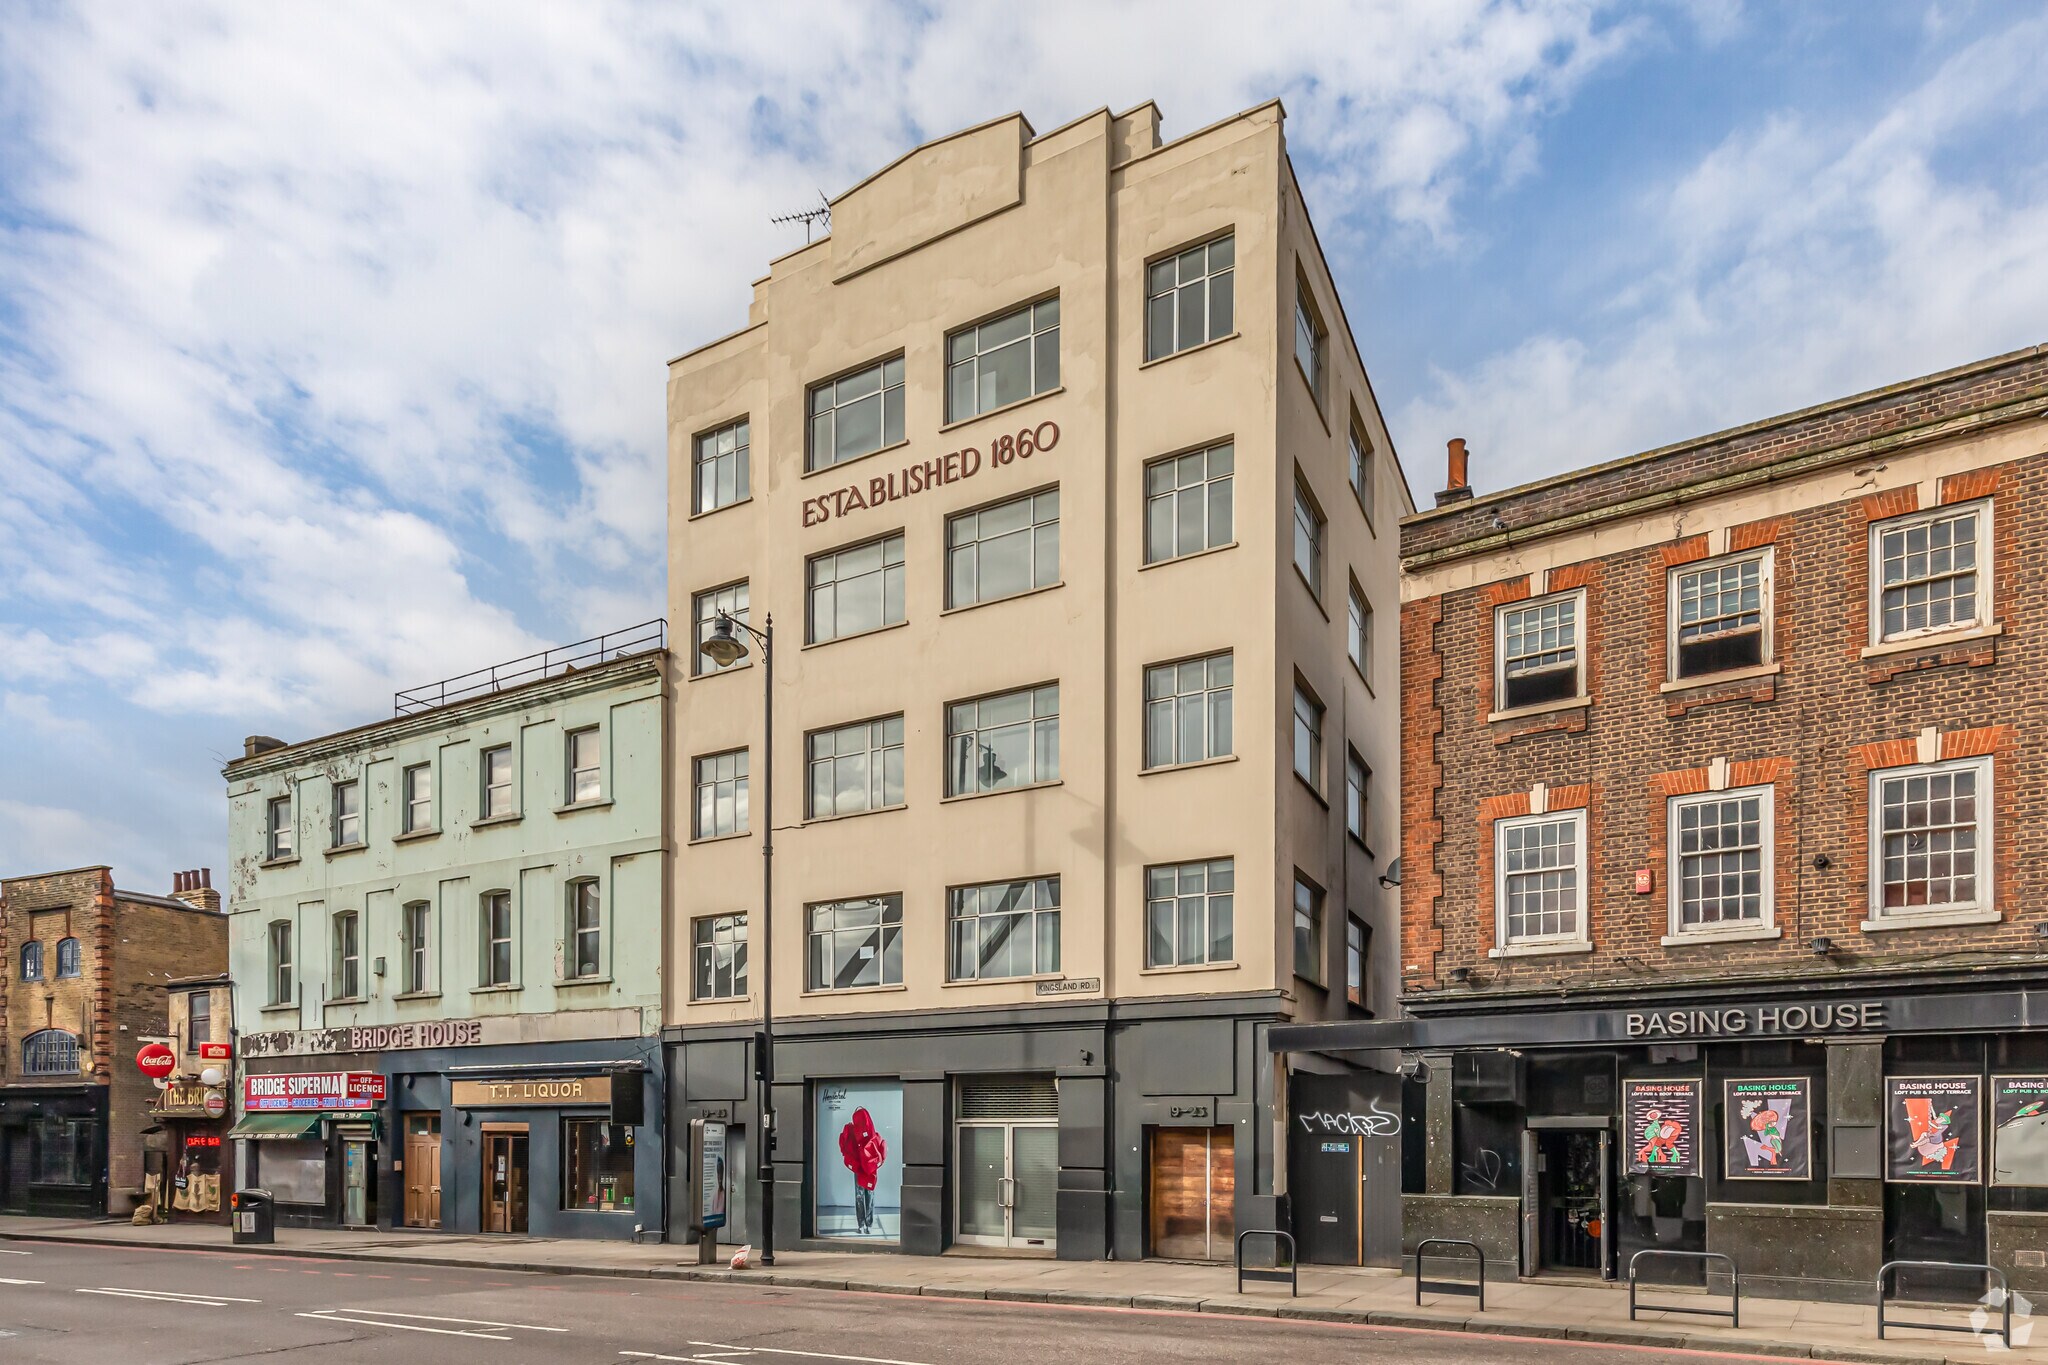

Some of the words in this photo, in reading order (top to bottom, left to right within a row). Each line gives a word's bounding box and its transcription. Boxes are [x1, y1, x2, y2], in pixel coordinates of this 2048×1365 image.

[802, 447, 981, 528] ESTABLISHED
[991, 420, 1061, 469] 1860
[1038, 982, 1077, 992] KINGSLAND
[1627, 1008, 1747, 1036] BASING
[1758, 1001, 1883, 1031] HOUSE
[351, 1025, 413, 1049] BRIDGE
[421, 1021, 482, 1046] HOUSE
[251, 1077, 286, 1096] BRIDGE
[288, 1075, 343, 1095] SUPERMA
[349, 1084, 383, 1093] LICENCE
[490, 1084, 517, 1098] T.T.
[524, 1083, 582, 1098] LIQUOR
[169, 1087, 185, 1107] THE
[292, 1098, 319, 1107] GROCERIES
